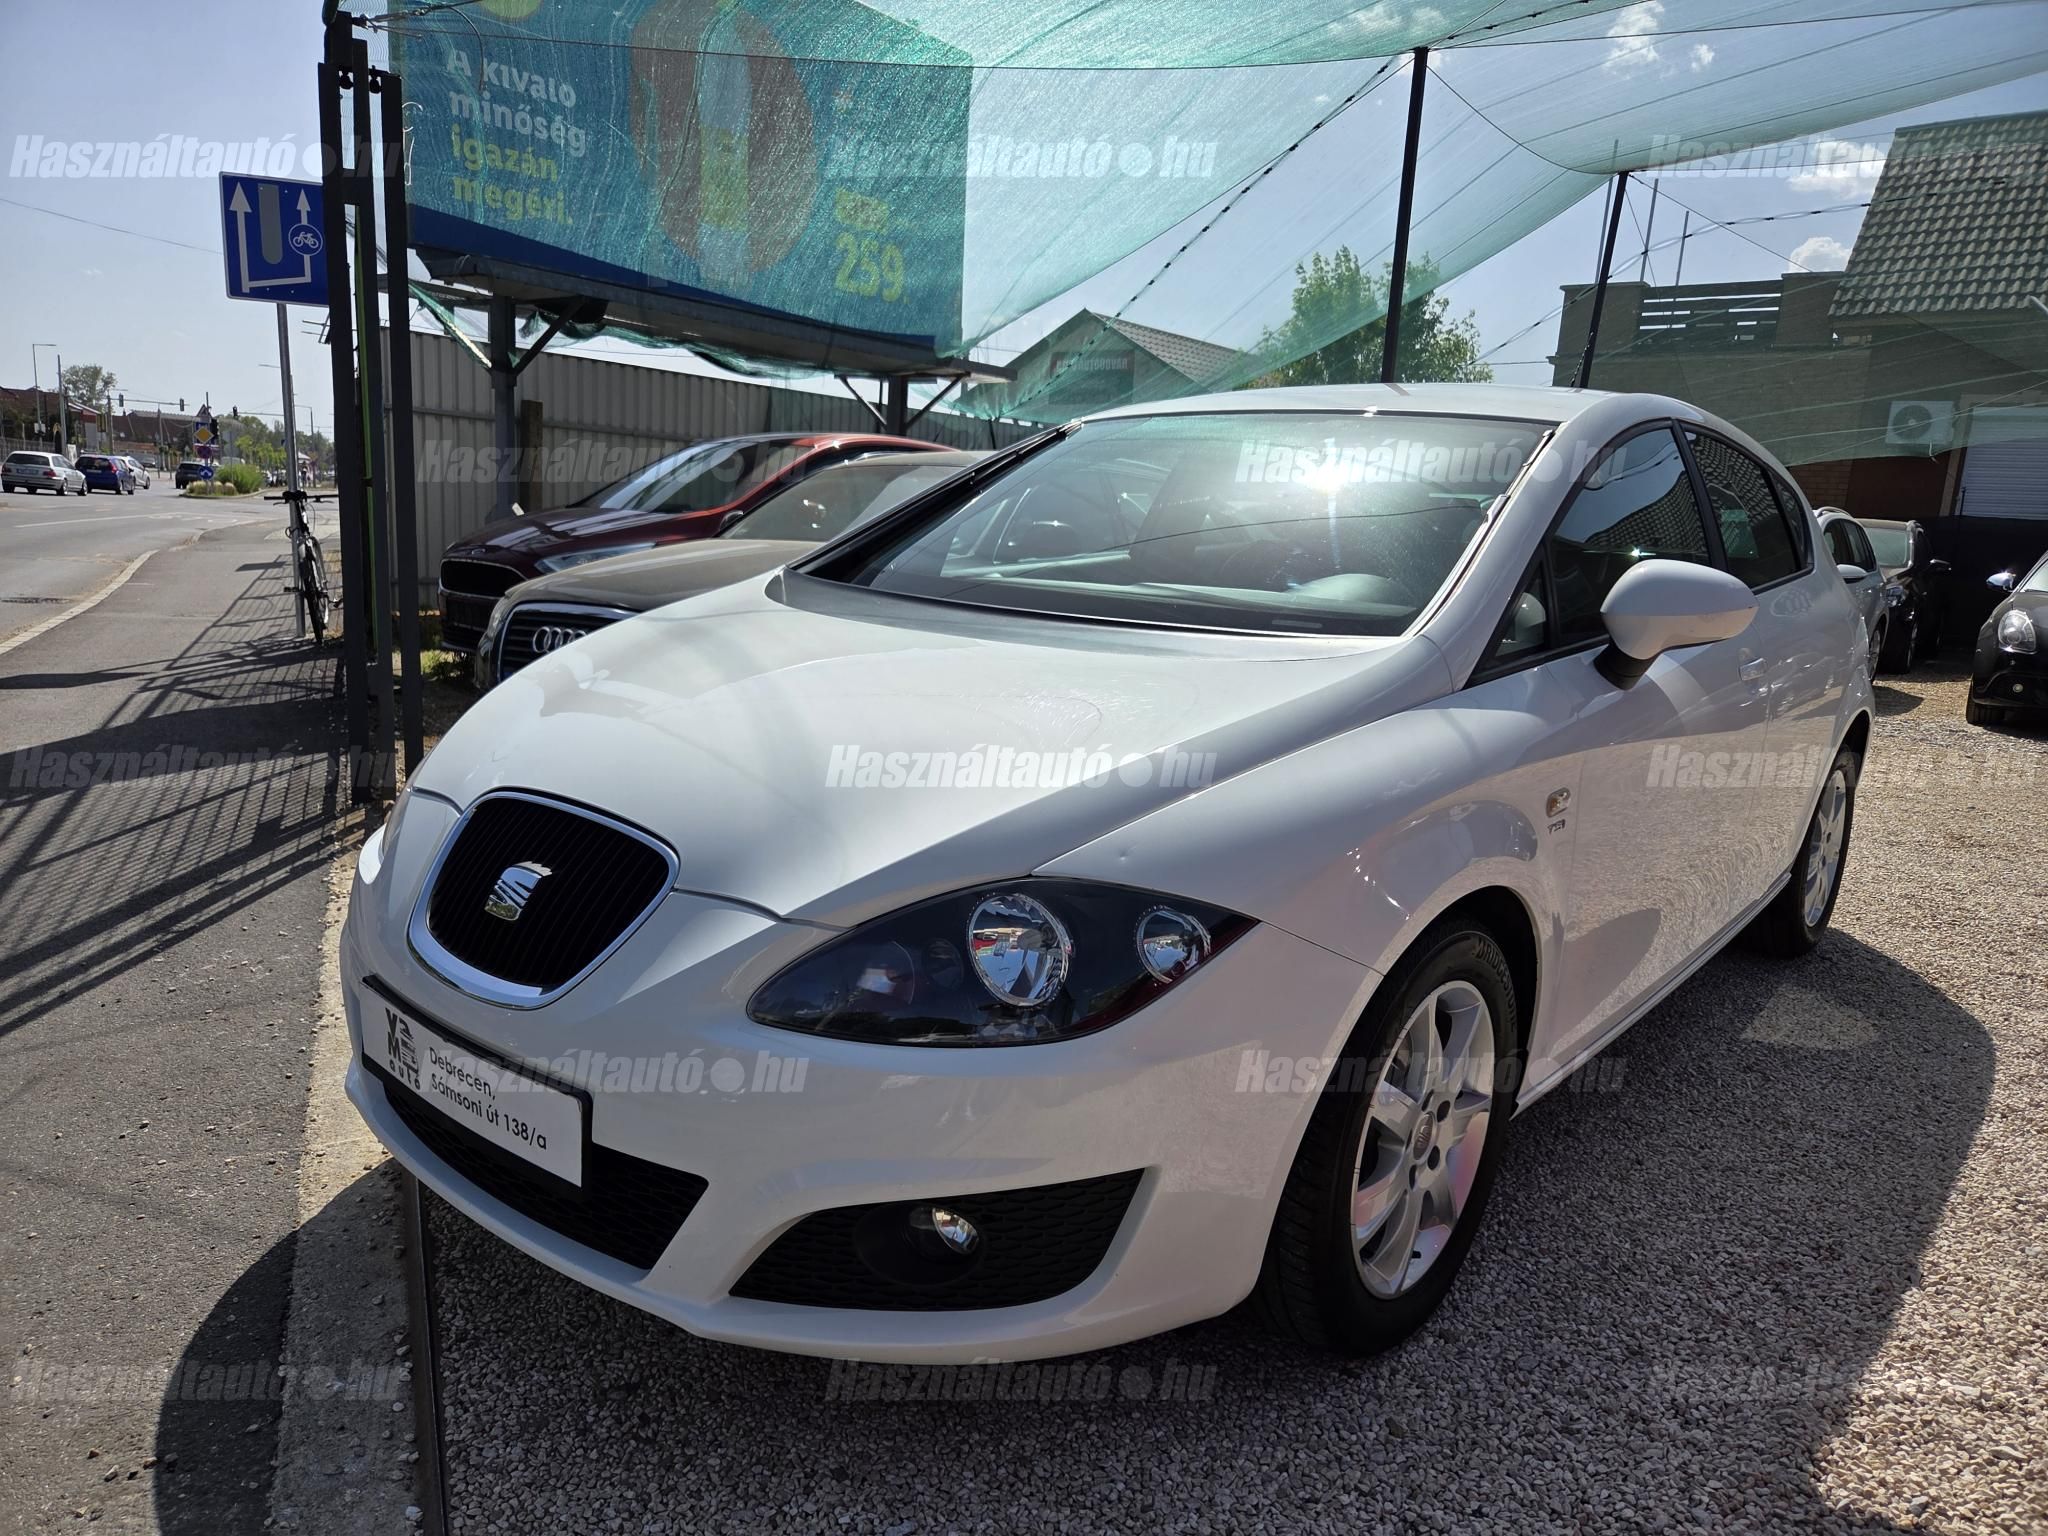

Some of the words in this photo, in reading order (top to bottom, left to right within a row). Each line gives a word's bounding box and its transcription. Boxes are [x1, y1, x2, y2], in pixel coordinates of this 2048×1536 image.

[447, 49, 473, 77] A
[450, 90, 587, 158] minőség
[452, 123, 558, 183] igazán
[429, 1046, 496, 1100] Debrecen,
[431, 1072, 483, 1118] Sámsoni
[486, 1103, 499, 1127] út
[504, 1114, 547, 1150] 138/a
